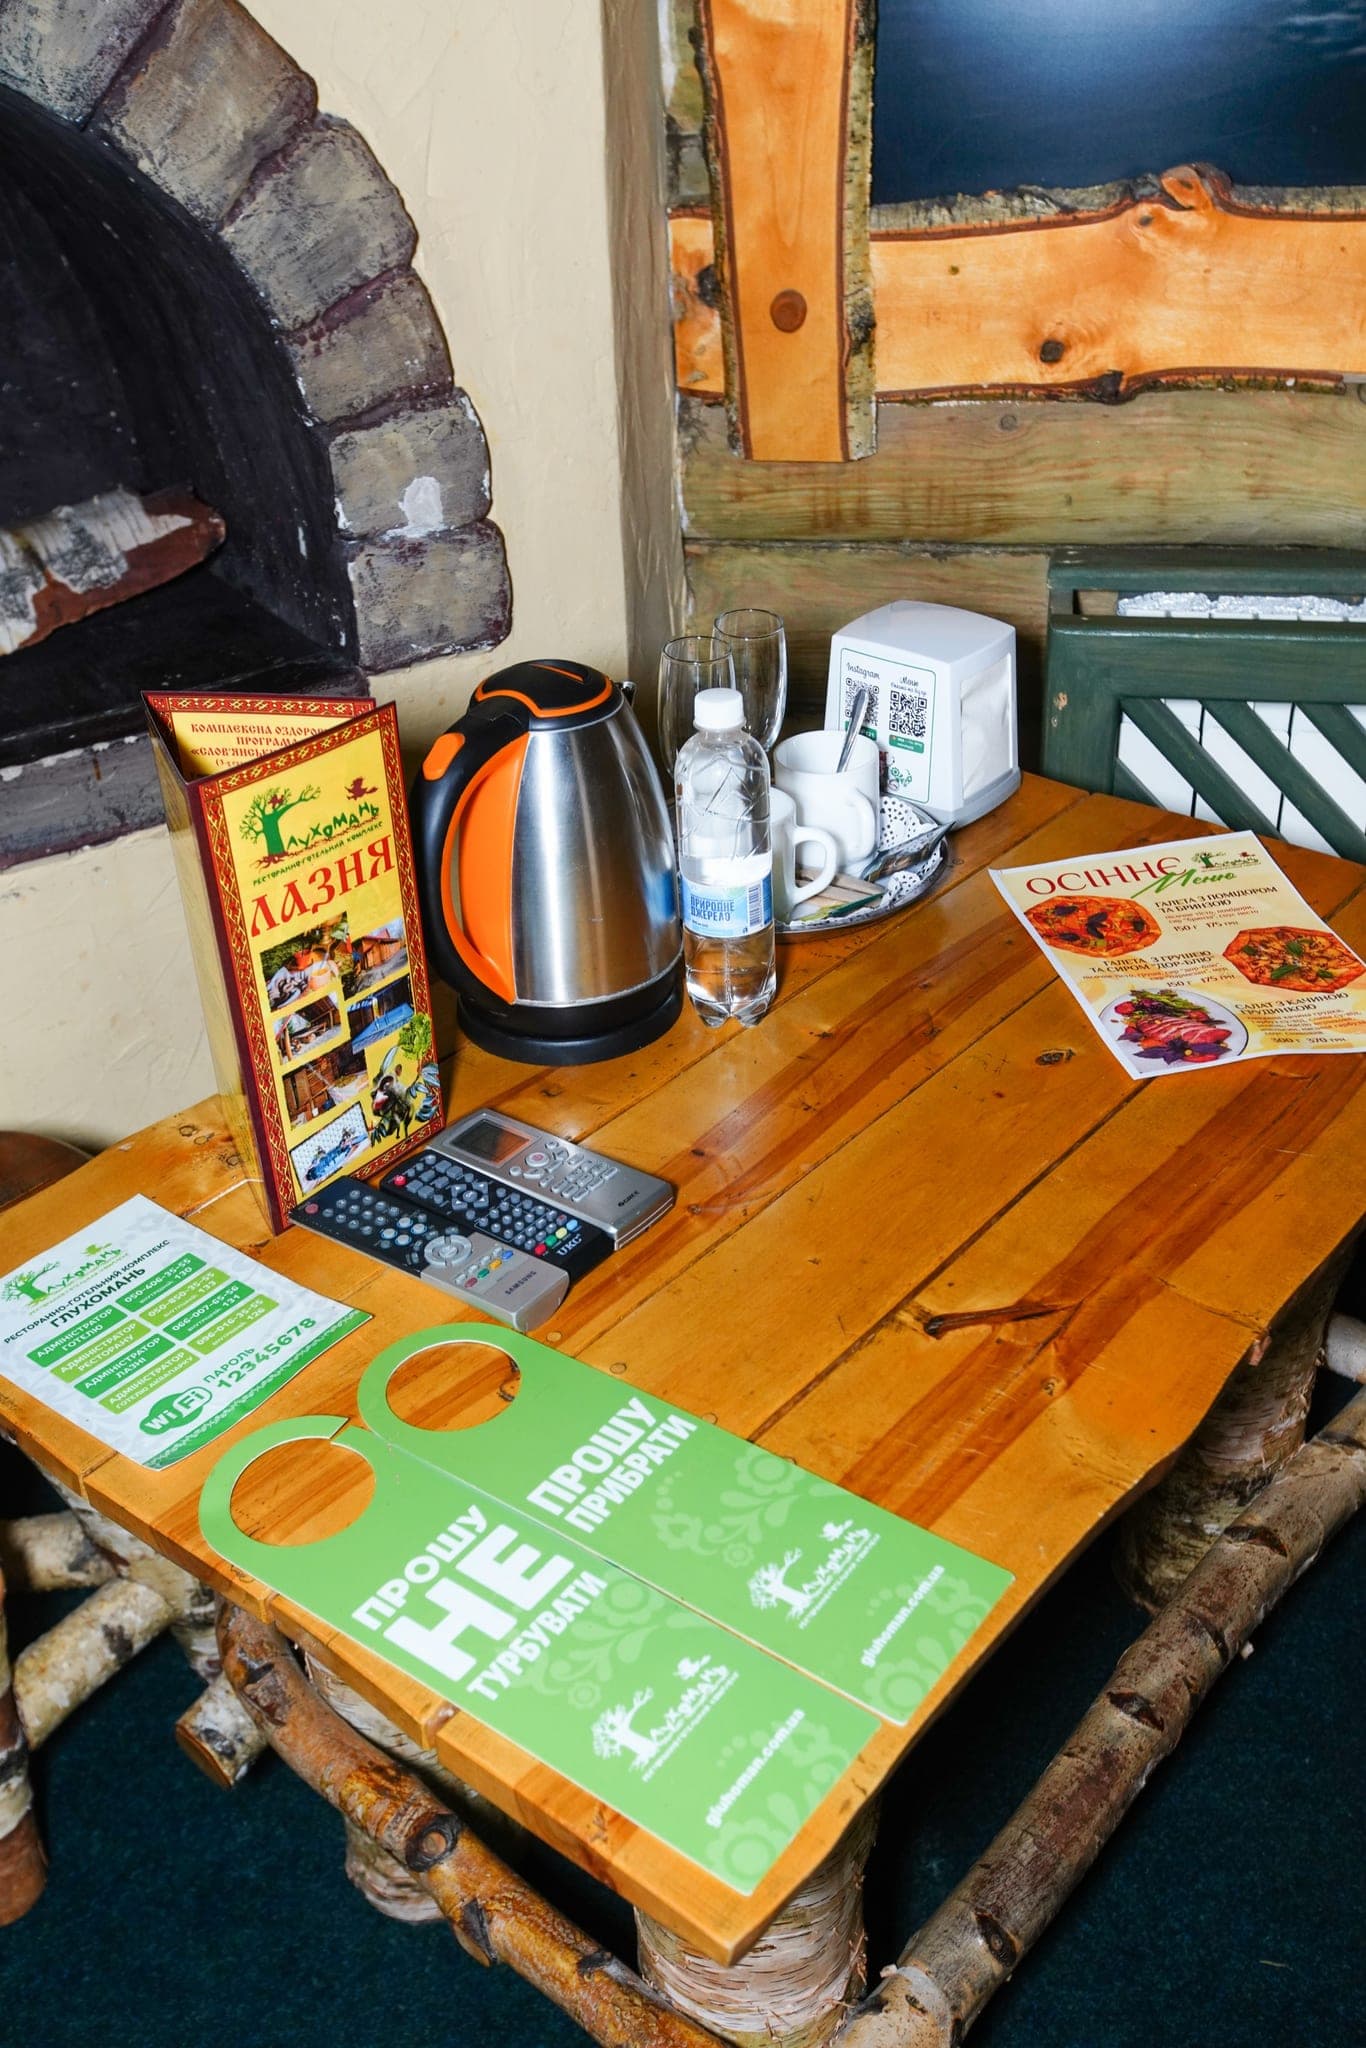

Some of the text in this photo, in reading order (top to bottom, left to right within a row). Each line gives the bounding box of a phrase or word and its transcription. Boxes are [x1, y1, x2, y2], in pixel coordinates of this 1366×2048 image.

[847, 663, 881, 680] Instagram
[191, 723, 272, 735] КОМПЛЕКСНА
[346, 821, 384, 845] КОМПЛЕКС
[250, 834, 395, 938] ЛАЗНЯ
[1026, 856, 1187, 896] ОСІННЄ
[1131, 868, 1237, 899] Меню
[690, 893, 735, 912] ПРИРОДНЕ
[691, 905, 731, 922] ДЖЕРЕЛО
[1154, 893, 1196, 909] ГАЛЕТА
[1205, 886, 1278, 902] ПОМІДОРОМ
[1159, 899, 1232, 914] ТА БРИНЗОЮ
[1173, 923, 1191, 933] 150
[1206, 920, 1223, 929] 175
[1089, 964, 1105, 973] ТА
[1106, 960, 1150, 973] СИРОМ
[1103, 955, 1147, 968] ГАЛЕТА
[1158, 950, 1212, 964] ГРУШЕЮ
[1167, 980, 1185, 989] 150
[1200, 975, 1218, 984] 175
[1235, 1000, 1275, 1013] САЛАТ
[1285, 992, 1349, 1008] КАЧИНОЮ
[557, 1234, 582, 1256] UKC
[4, 1270, 125, 1344] РЕСТОРАННО-ГОТЕЛЬНИЙ
[122, 1239, 170, 1275] КОМПЛЕКС
[124, 1257, 192, 1304] 050-406-35-55
[174, 1266, 194, 1284] 130
[505, 1270, 537, 1295] SAMSUNG
[50, 1267, 147, 1329] ГЛУХОМАНЬ
[222, 1293, 241, 1310] 131
[36, 1308, 114, 1359] АДМІНІСТРАТОР
[60, 1322, 138, 1375] АДМІНІСТРАТОР
[61, 1322, 104, 1352] ГОТЕЛЮ
[78, 1334, 135, 1375] РЕСТОРАНУ
[84, 1337, 161, 1390] АДМІНІСТРАТОР
[115, 1356, 147, 1380] ЛАЗНІ
[203, 1346, 256, 1385] ПАРОЛЬ
[217, 1317, 318, 1391] 12345678
[108, 1351, 186, 1406] АДМІНІСТРАТОР
[526, 1397, 657, 1517] ПРОШУ
[564, 1413, 698, 1533] ПРИБРАТИ
[351, 1503, 488, 1632] ПРОШУ
[383, 1523, 575, 1683] НЕ
[861, 1564, 946, 1668] gluhoman.com.ua
[466, 1570, 609, 1701] ТУРБУВАТИ
[706, 1708, 806, 1829] gluhoman.com.ua
